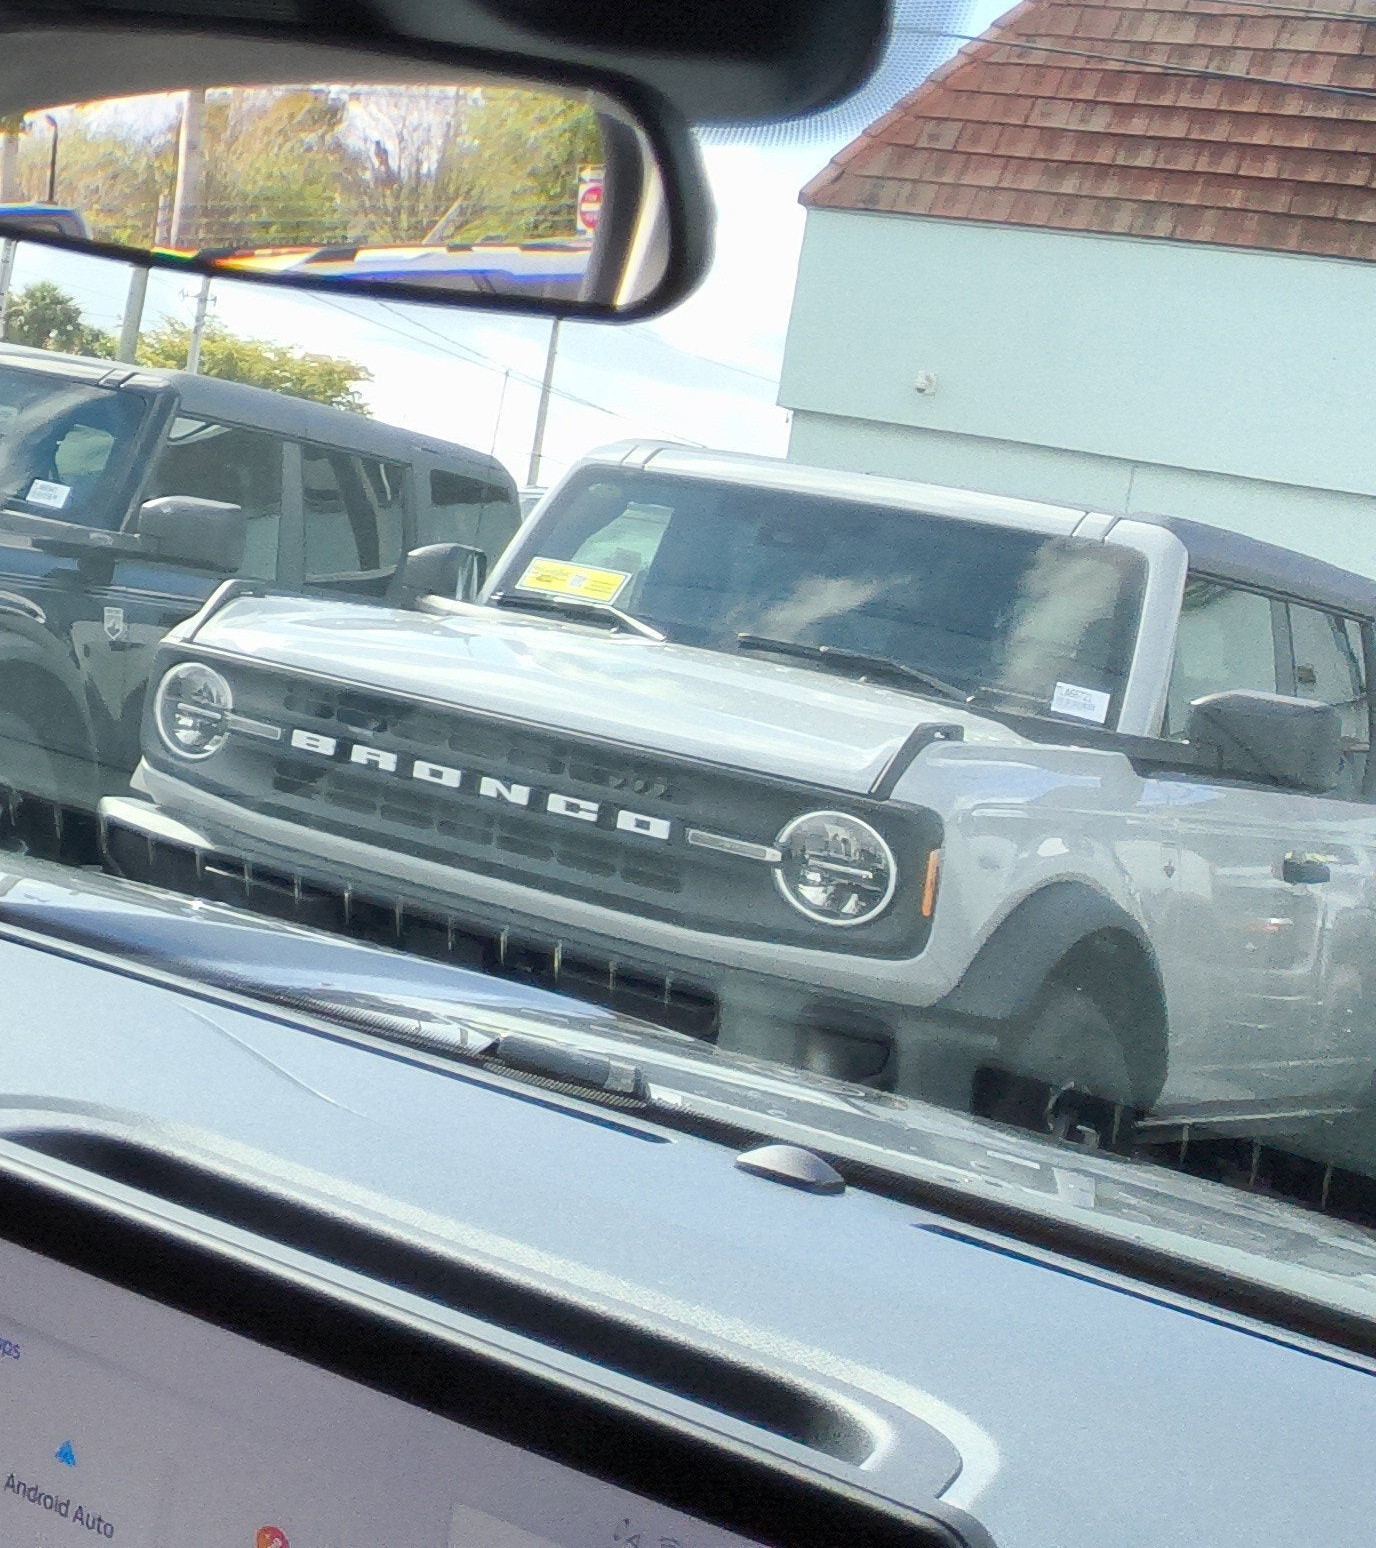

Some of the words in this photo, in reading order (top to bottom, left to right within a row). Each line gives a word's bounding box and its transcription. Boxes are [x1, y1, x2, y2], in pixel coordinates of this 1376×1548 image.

[291, 729, 671, 840] BRONCO
[4, 1472, 71, 1519] Android
[72, 1505, 115, 1539] Auto
